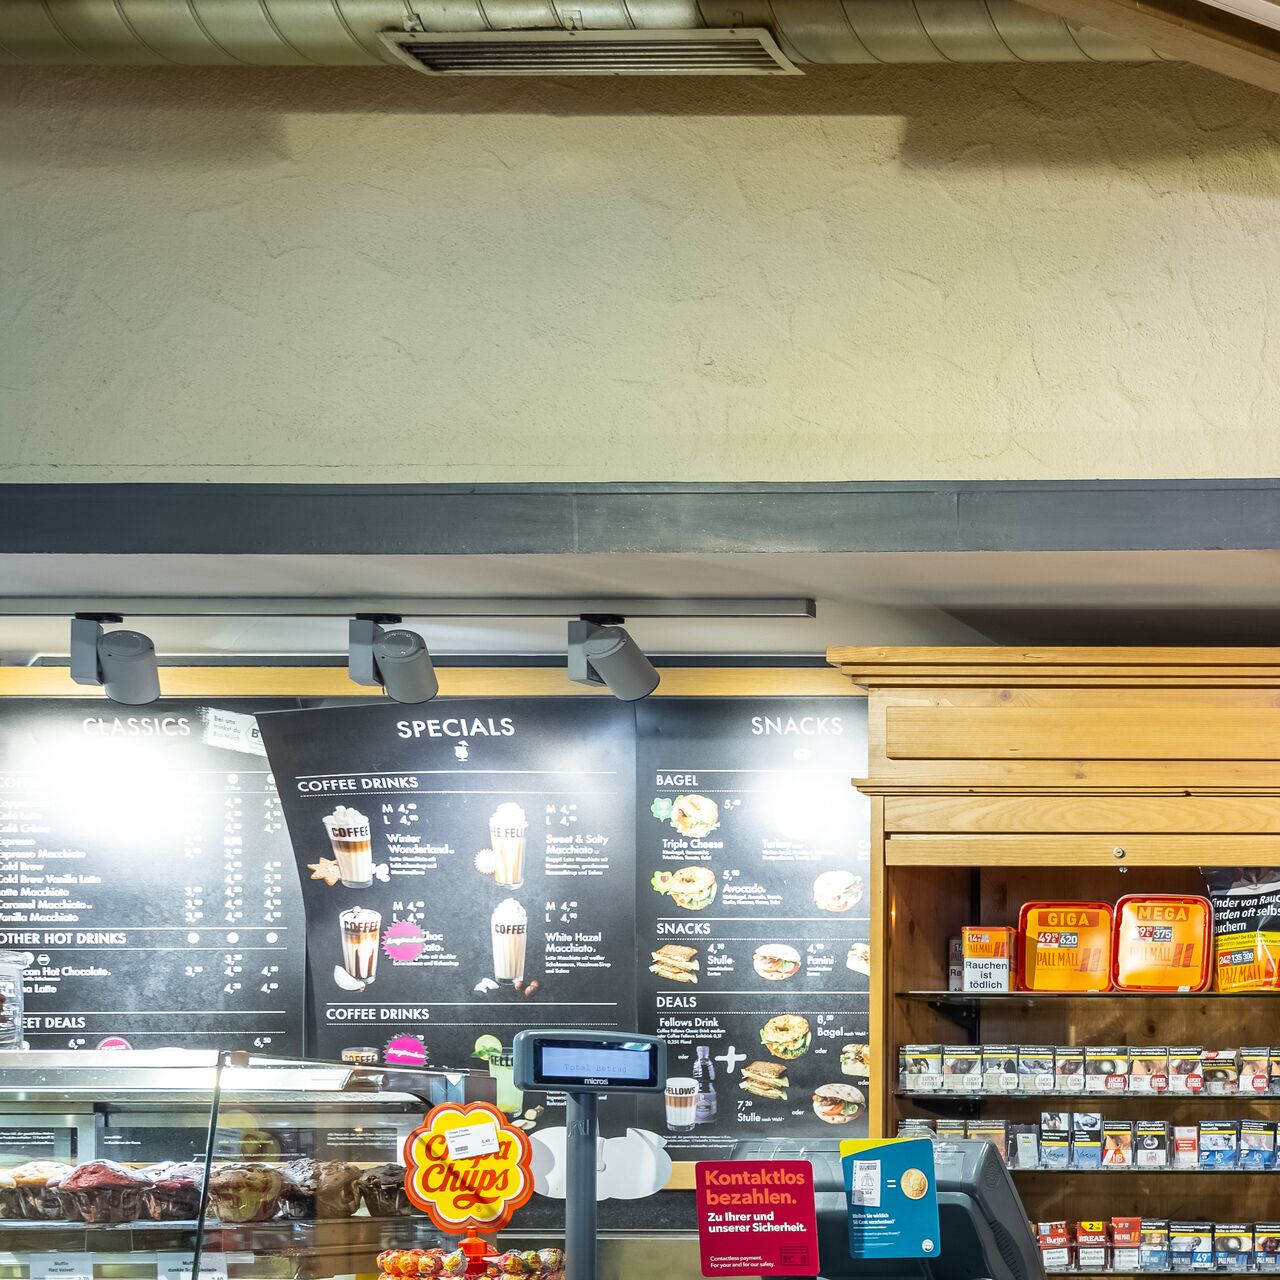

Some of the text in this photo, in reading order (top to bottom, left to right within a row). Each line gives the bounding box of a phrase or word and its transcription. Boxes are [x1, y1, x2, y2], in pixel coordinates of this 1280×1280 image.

[83, 717, 190, 737] CLASSICS
[396, 718, 515, 738] SPECIALS
[751, 717, 843, 735] SNACKS
[297, 777, 419, 792] COFFEE DRINKS
[656, 775, 698, 786] BAGEL
[387, 834, 421, 843] Winter
[576, 835, 583, 844] &
[585, 835, 608, 846] Salty
[662, 839, 723, 849] Triple Cheese
[387, 844, 448, 854] Wonderland
[1241, 898, 1257, 907] von
[1138, 906, 1188, 921] MEGA
[1240, 907, 1254, 918] oft
[1048, 913, 1090, 927] GIGA
[656, 923, 711, 934] SNACKS
[44, 933, 72, 944] HOT
[76, 933, 126, 944] DRINKS
[545, 933, 601, 942] White Hazel
[545, 944, 593, 953] Macchiato
[807, 955, 834, 965] Panini
[1036, 948, 1080, 967] PALL MALL
[965, 961, 1008, 971] Rauchen
[980, 971, 992, 980] ist
[969, 979, 1003, 989] tödlich
[656, 997, 697, 1008] DEALS
[326, 1008, 430, 1020] COFFEE DRINKS
[45, 1017, 86, 1028] DEALS
[660, 1018, 719, 1027] Fellows Drink
[817, 1028, 843, 1038] Bagel
[584, 1078, 608, 1086] micros
[665, 1086, 696, 1096] FELLOWS
[737, 1112, 761, 1123] Stulle
[422, 1164, 509, 1195] Chups
[705, 1168, 805, 1186] Kontaktlos
[706, 1190, 797, 1205] bezahlen.
[708, 1211, 774, 1222] Zu Ihrer und
[708, 1222, 807, 1233] unserer Sicherheit.
